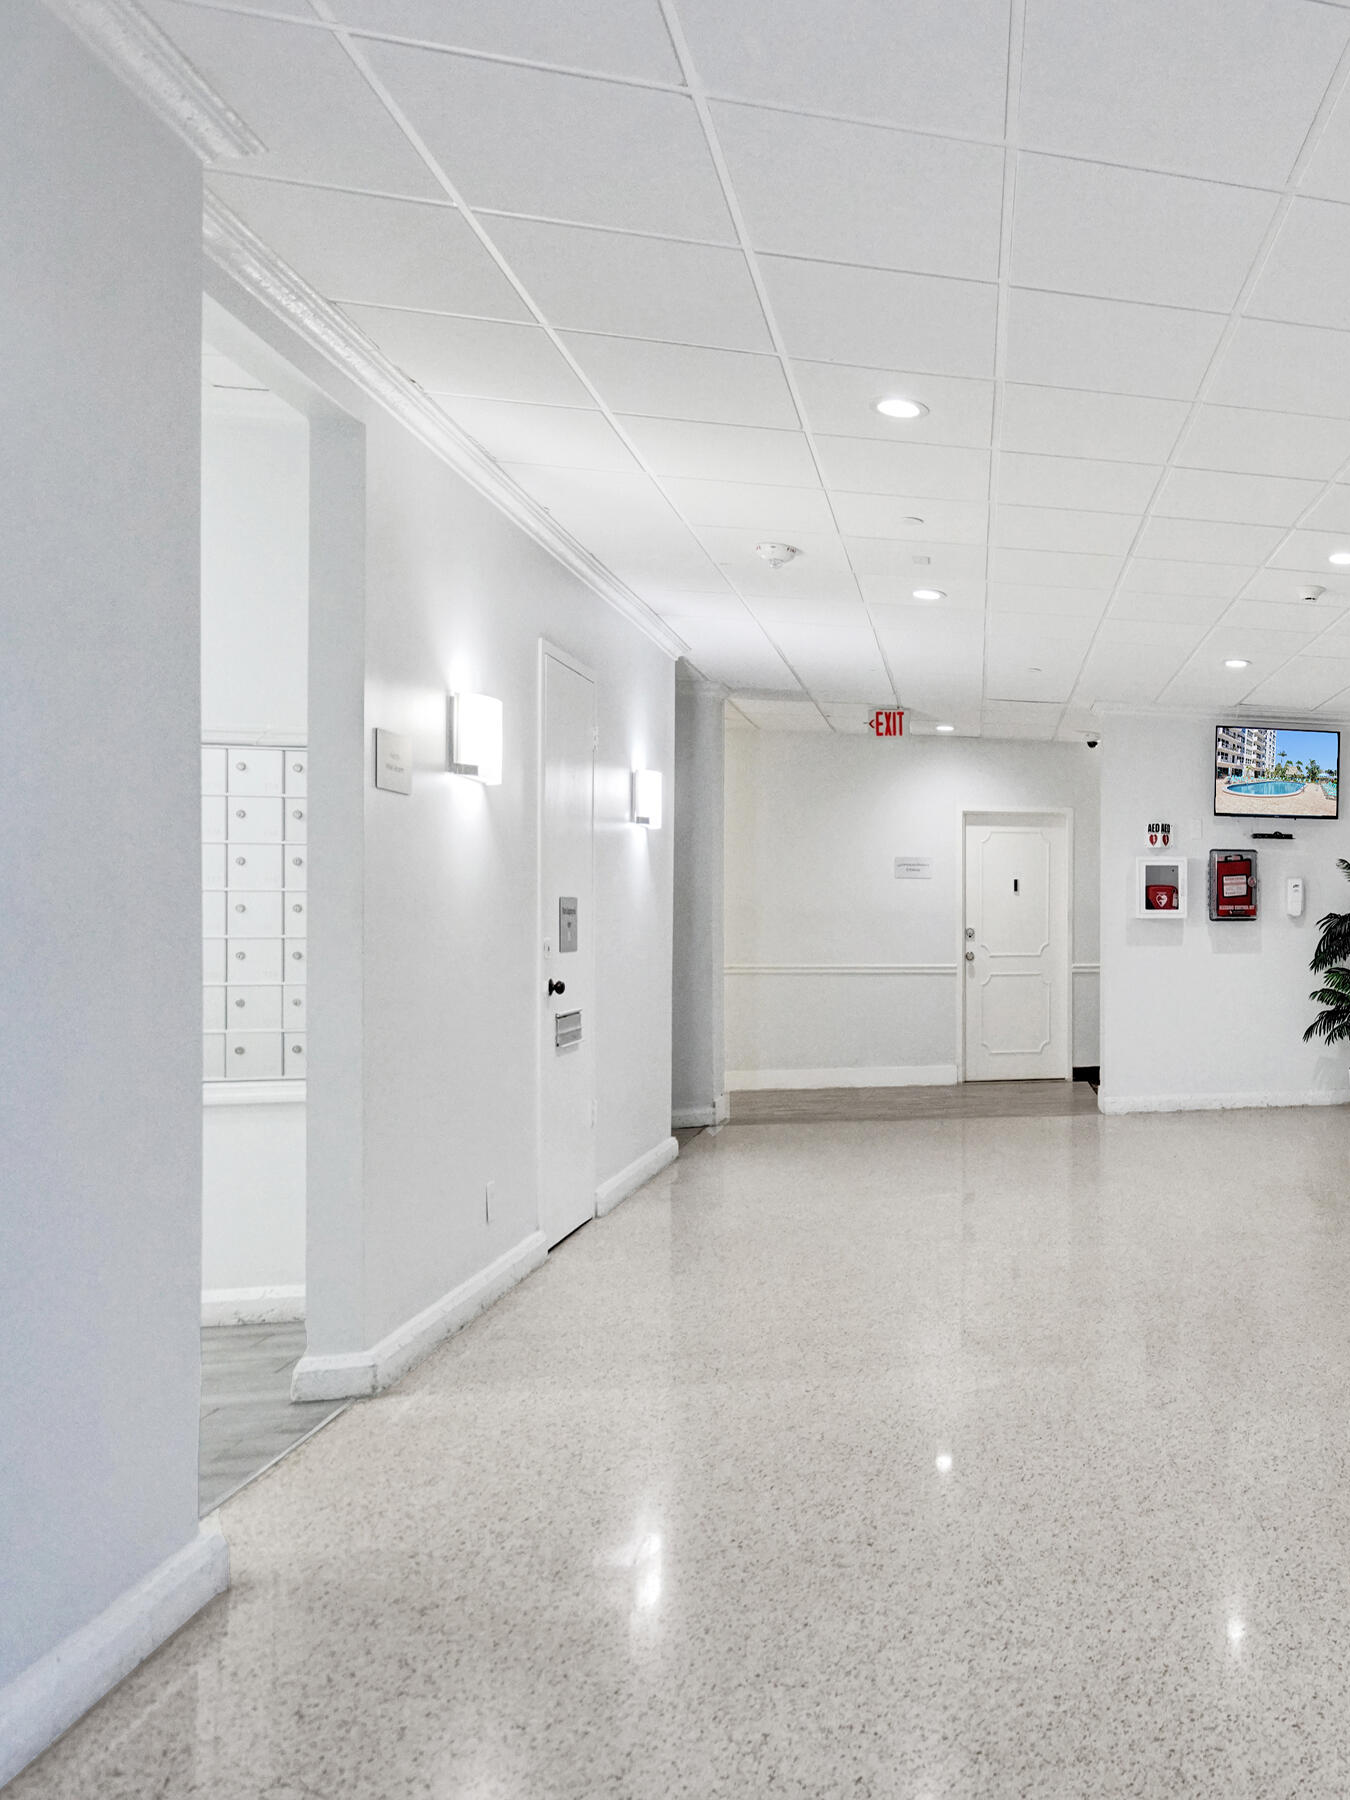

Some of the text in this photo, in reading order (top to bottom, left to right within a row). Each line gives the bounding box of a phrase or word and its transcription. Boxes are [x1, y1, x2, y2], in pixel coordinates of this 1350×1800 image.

[875, 711, 904, 736] EXIT
[1148, 823, 1160, 833] AED
[1161, 823, 1171, 833] AED
